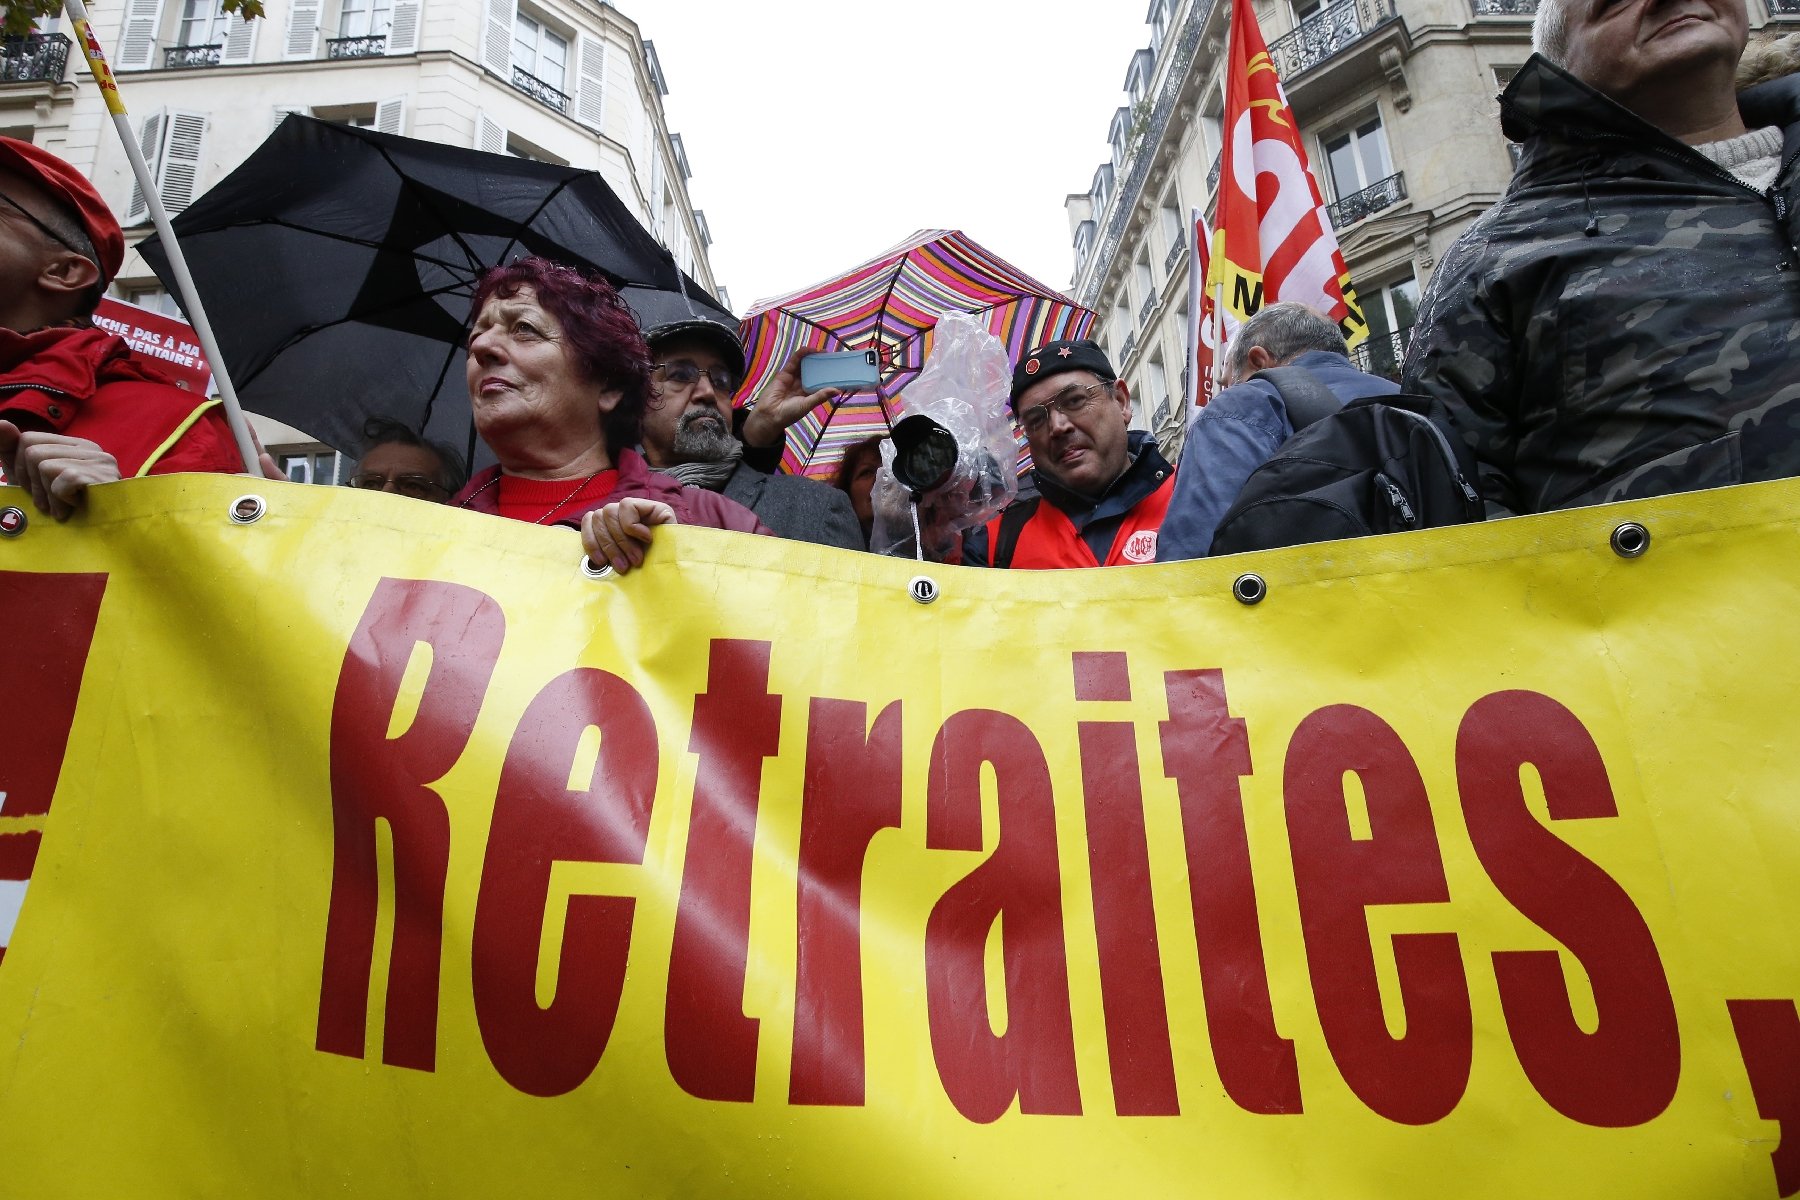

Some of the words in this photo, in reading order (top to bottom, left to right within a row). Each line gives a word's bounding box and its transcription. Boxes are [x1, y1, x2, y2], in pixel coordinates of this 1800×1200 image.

[120, 334, 194, 368] MENTAIRE
[196, 360, 204, 371] !
[132, 327, 162, 345] PAS
[163, 335, 175, 350] À
[178, 341, 200, 358] MA
